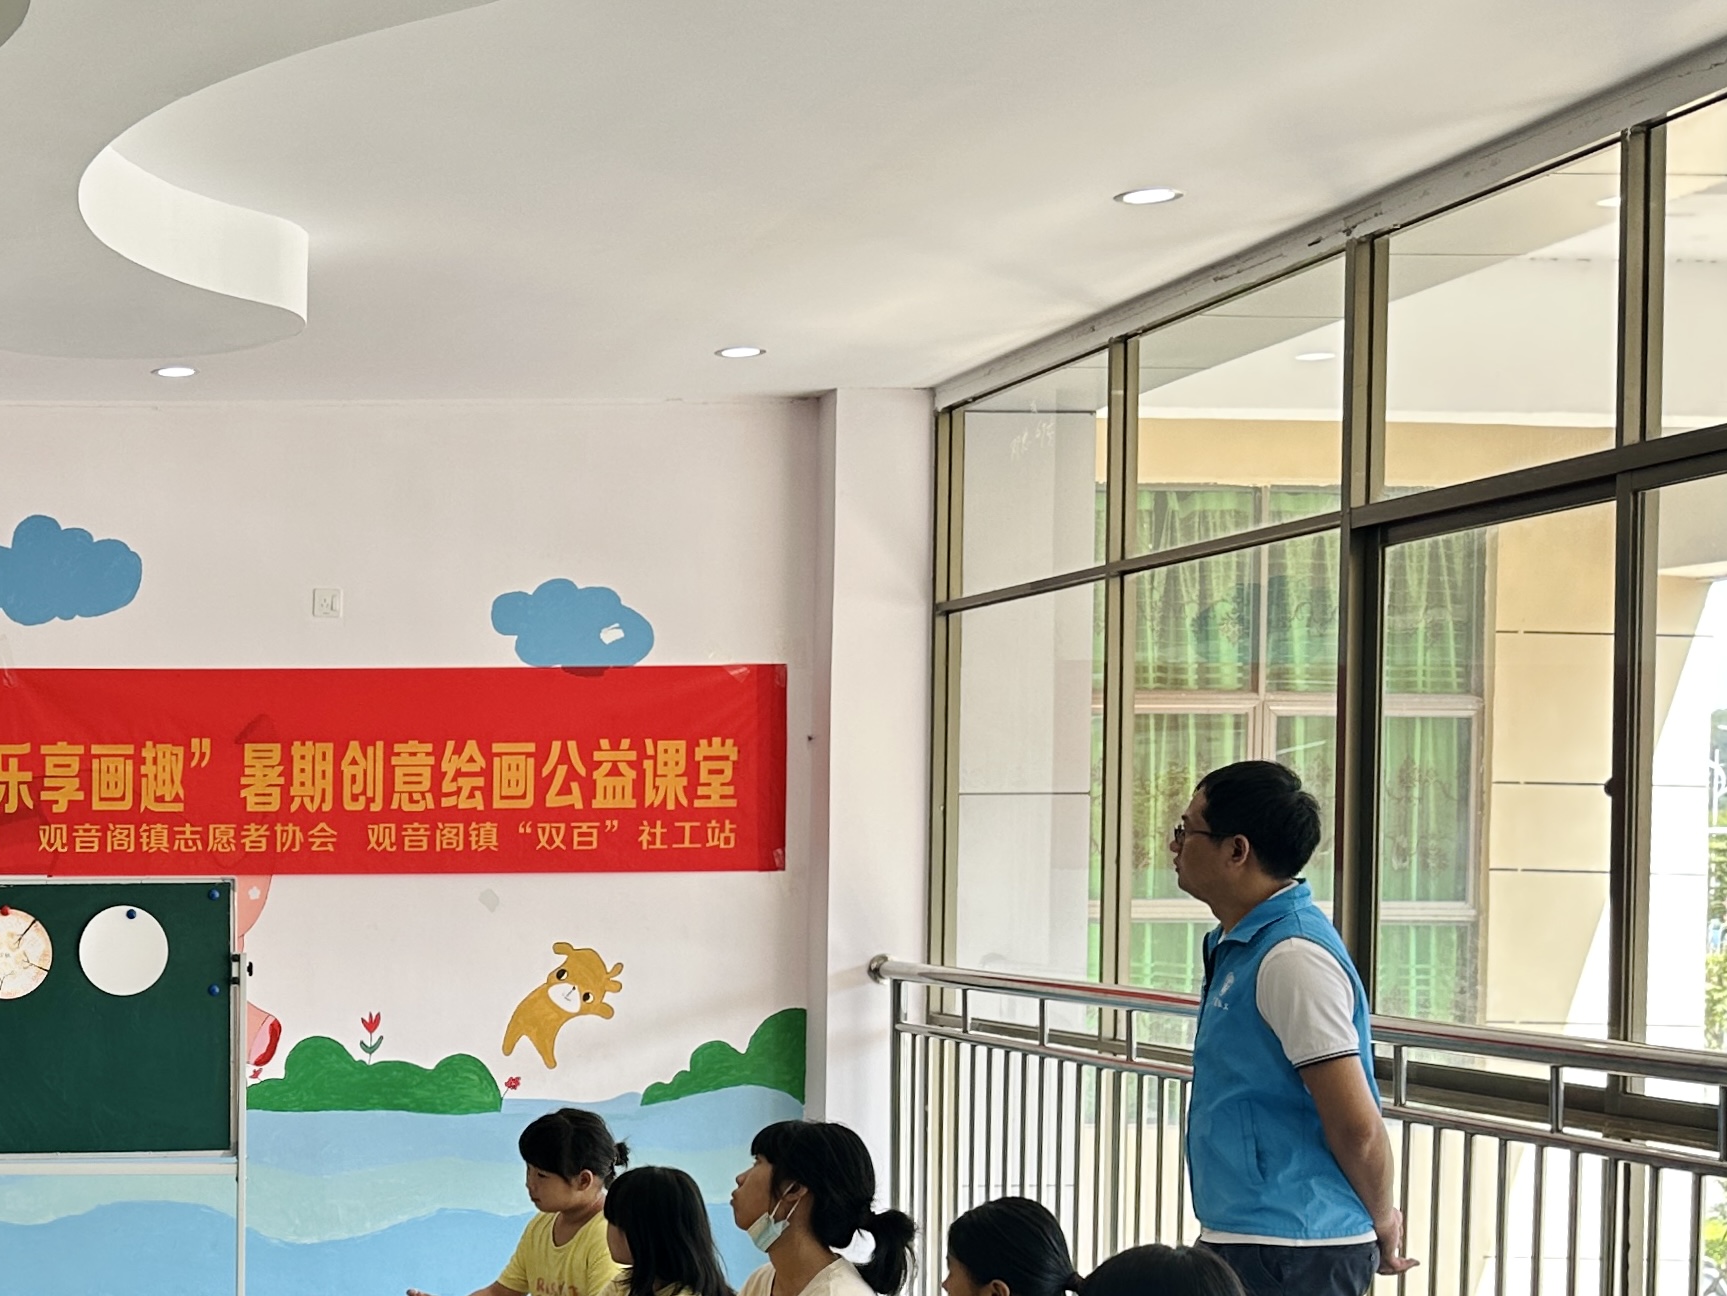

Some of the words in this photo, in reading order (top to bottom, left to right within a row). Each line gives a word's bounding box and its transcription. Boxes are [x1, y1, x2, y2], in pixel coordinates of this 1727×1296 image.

[38, 821, 338, 853] 观音阁镇志愿者协会
[367, 819, 737, 852] 观音阁镇“双百”社工站
